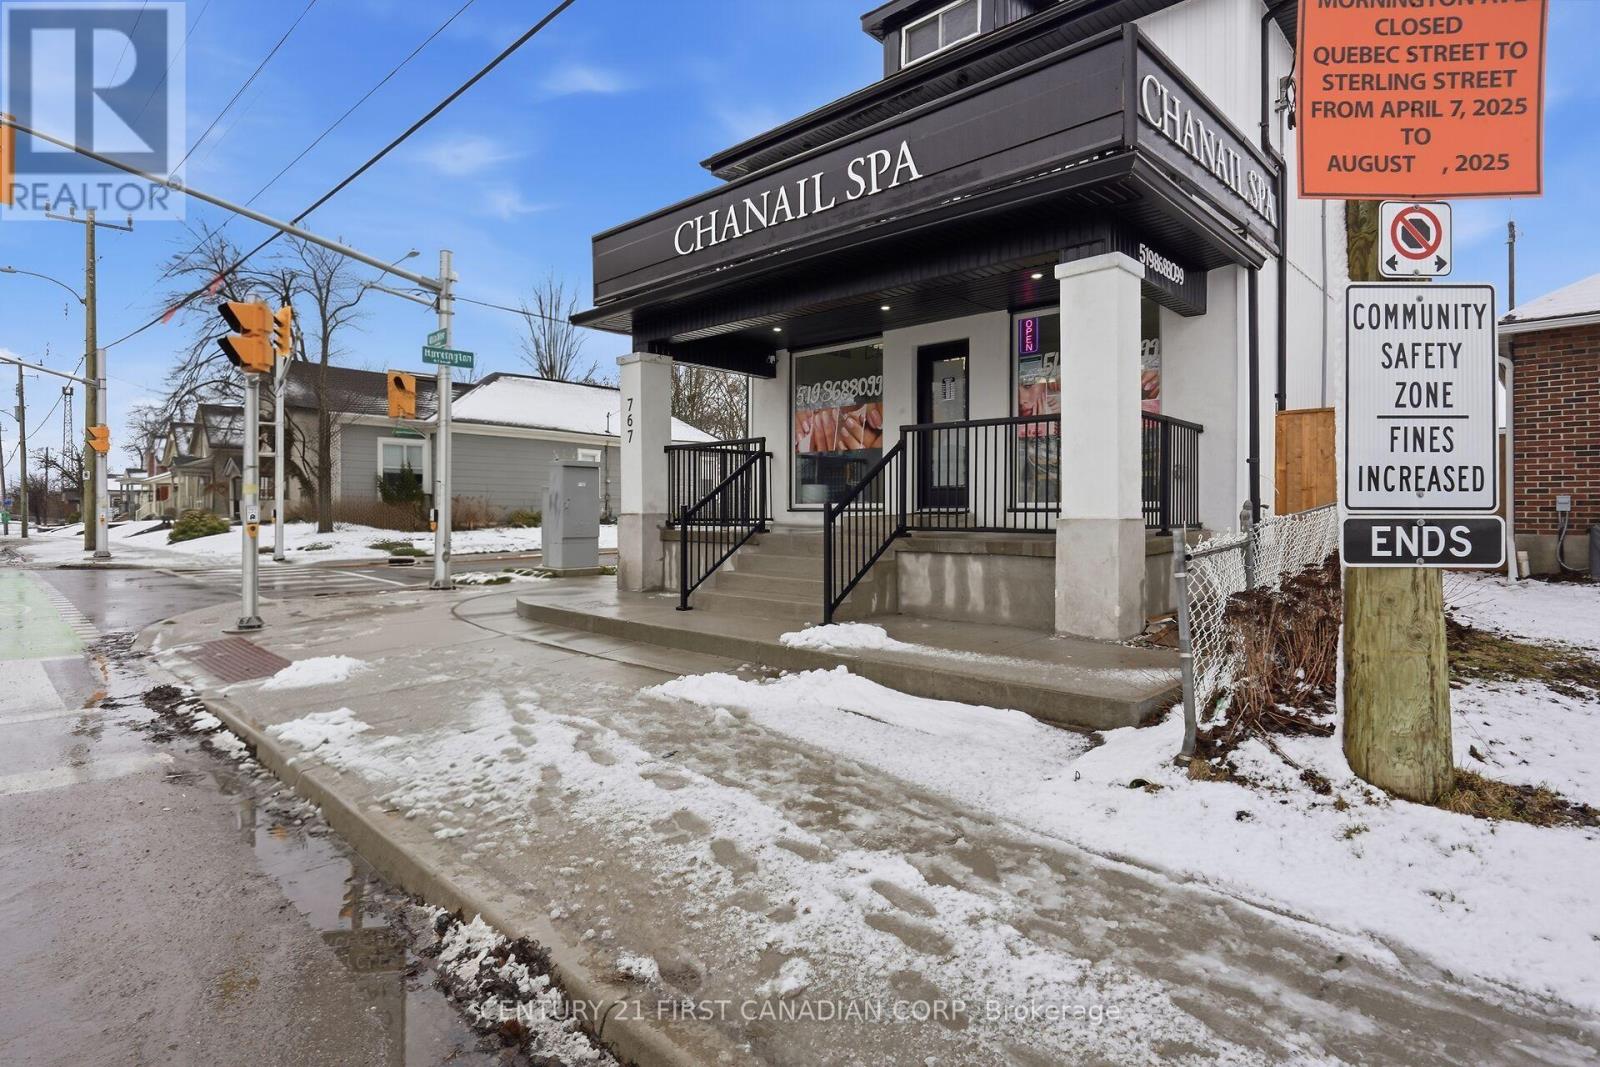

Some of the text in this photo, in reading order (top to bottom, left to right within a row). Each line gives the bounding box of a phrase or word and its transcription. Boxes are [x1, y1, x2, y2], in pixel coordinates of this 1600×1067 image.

[1374, 16, 1463, 36] CLOSED
[1313, 40, 1528, 66] QUEBEC STREET TO
[1321, 69, 1518, 92] STERLING STREET
[1311, 97, 1528, 120] FROM APRIL 7, 2025
[1400, 127, 1432, 146] TO
[1141, 74, 1278, 229] CHANAIL SPA
[1327, 154, 1416, 173] AUGUST
[1454, 153, 1511, 172] 2025
[673, 140, 924, 256] CHANAIL SPA
[1353, 303, 1487, 330] COMMUNITY
[1025, 319, 1034, 352] OPEN
[1381, 342, 1463, 369] SAFETY
[1395, 381, 1454, 408] ZONE
[1390, 425, 1455, 453] FINES
[1358, 465, 1486, 492] INCREASED
[1371, 525, 1473, 558] ENDS
